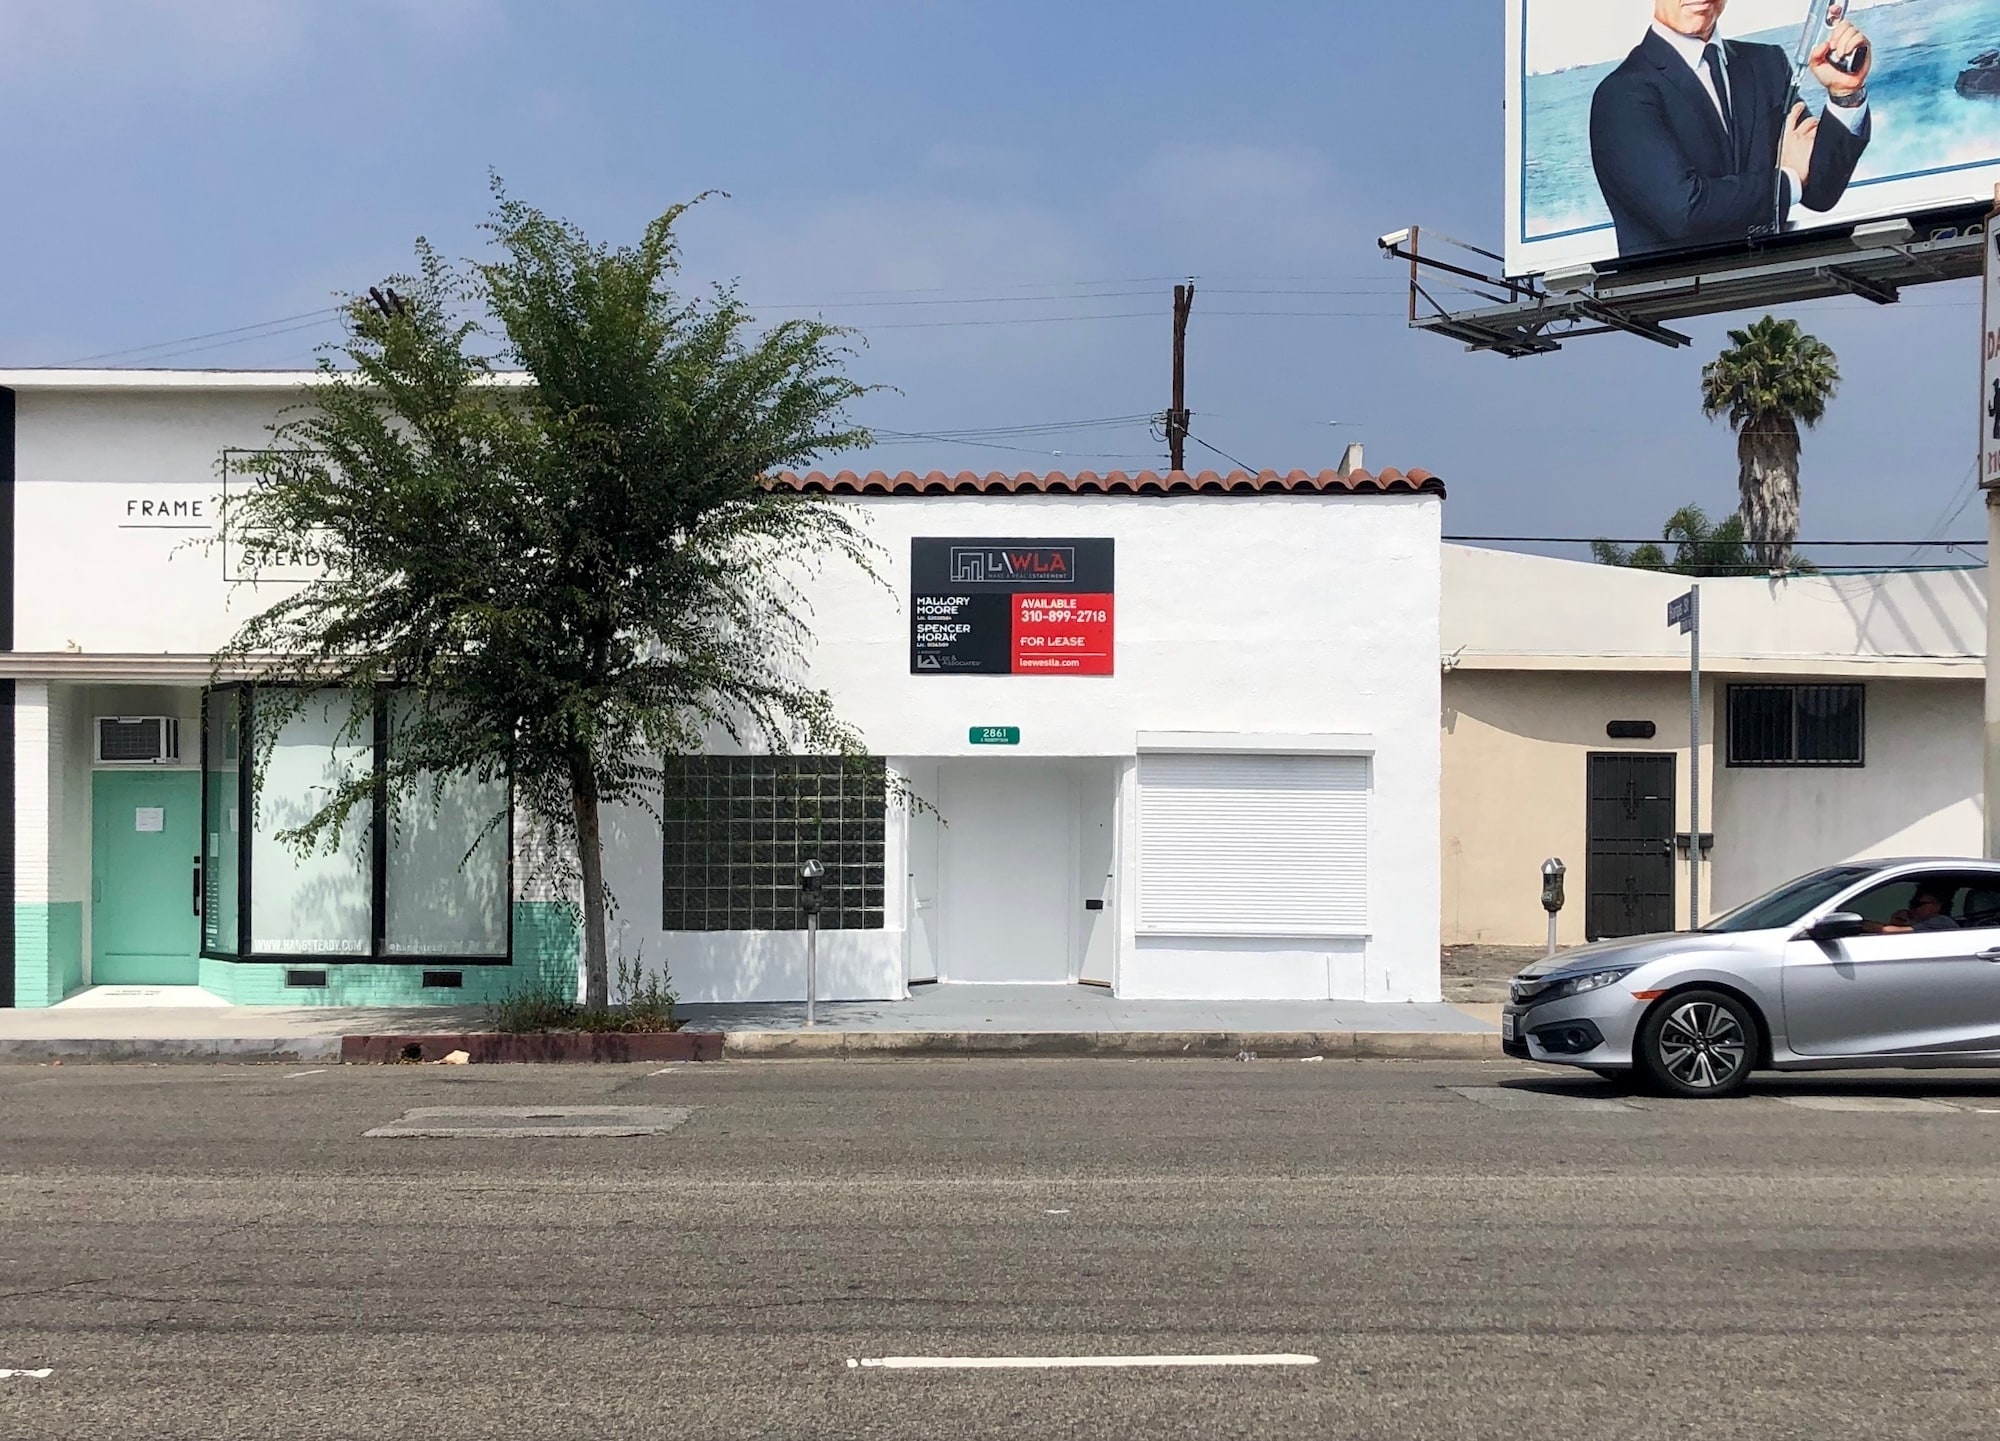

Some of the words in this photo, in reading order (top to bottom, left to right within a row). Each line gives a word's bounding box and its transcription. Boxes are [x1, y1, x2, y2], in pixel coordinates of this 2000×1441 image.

[127, 499, 203, 517] FRAME
[916, 596, 970, 606] MALLORY
[1021, 599, 1078, 609] AVAILABLE
[916, 605, 959, 615] MOORE
[1021, 610, 1107, 623] 310-899-2718
[916, 624, 971, 633] SPENCER
[916, 633, 958, 642] HORAK
[1020, 636, 1045, 647] FOR
[1047, 636, 1086, 647] LEASE
[1019, 657, 1080, 668] leewestla.com
[982, 728, 1008, 738] 2861
